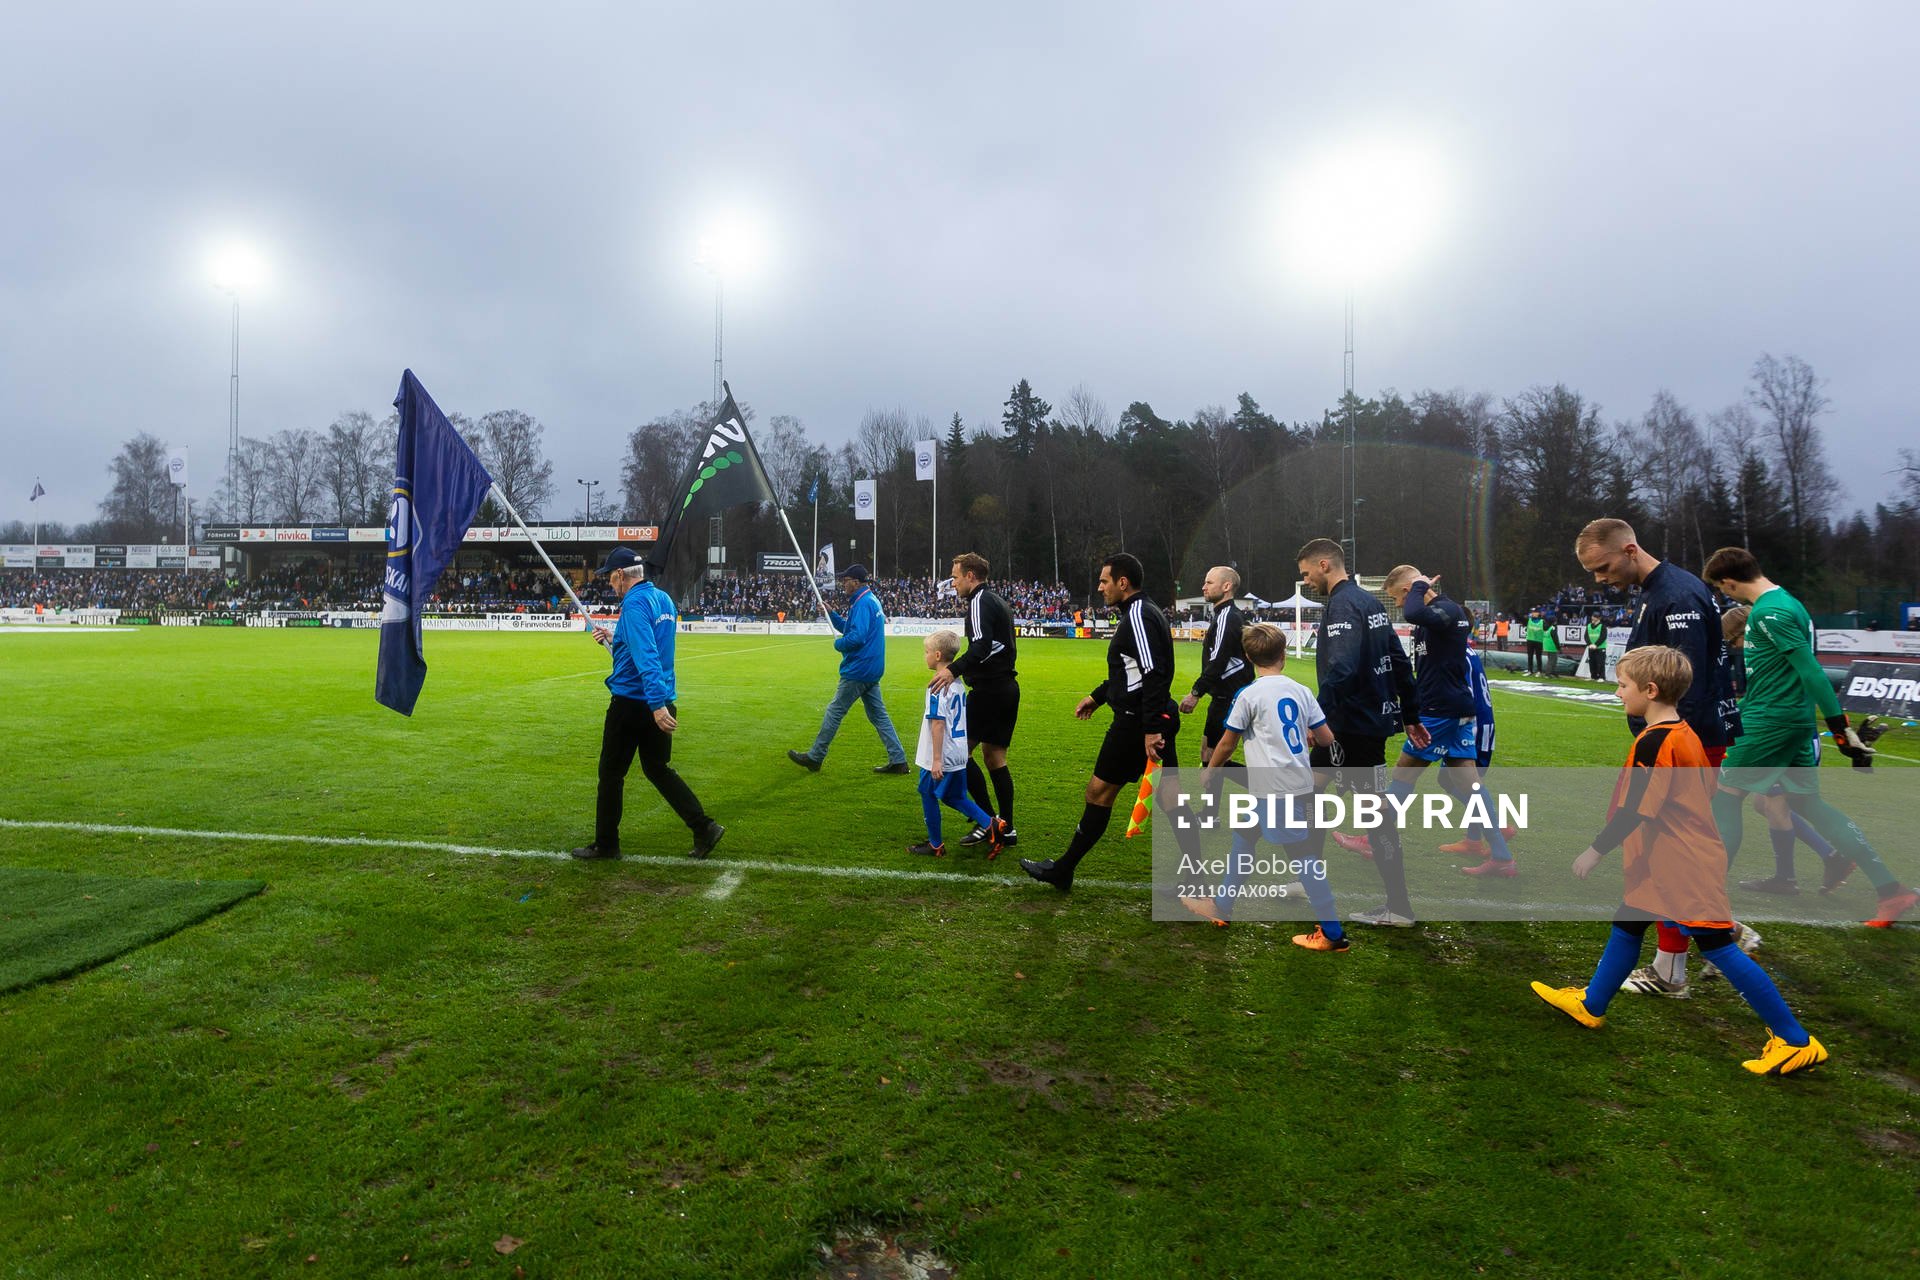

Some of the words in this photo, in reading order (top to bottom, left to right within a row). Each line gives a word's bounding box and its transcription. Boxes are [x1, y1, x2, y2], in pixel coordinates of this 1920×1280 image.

[277, 530, 310, 541] nivika.
[78, 615, 119, 625] UNIBET
[160, 616, 202, 626] UNIBET
[1665, 610, 1701, 622] morris
[245, 617, 288, 628] UNIBET
[422, 620, 454, 629] OMINIT
[520, 620, 562, 629] Finnvedens
[562, 620, 572, 628] Bil
[1667, 621, 1689, 631] law.
[1277, 697, 1304, 755] 8
